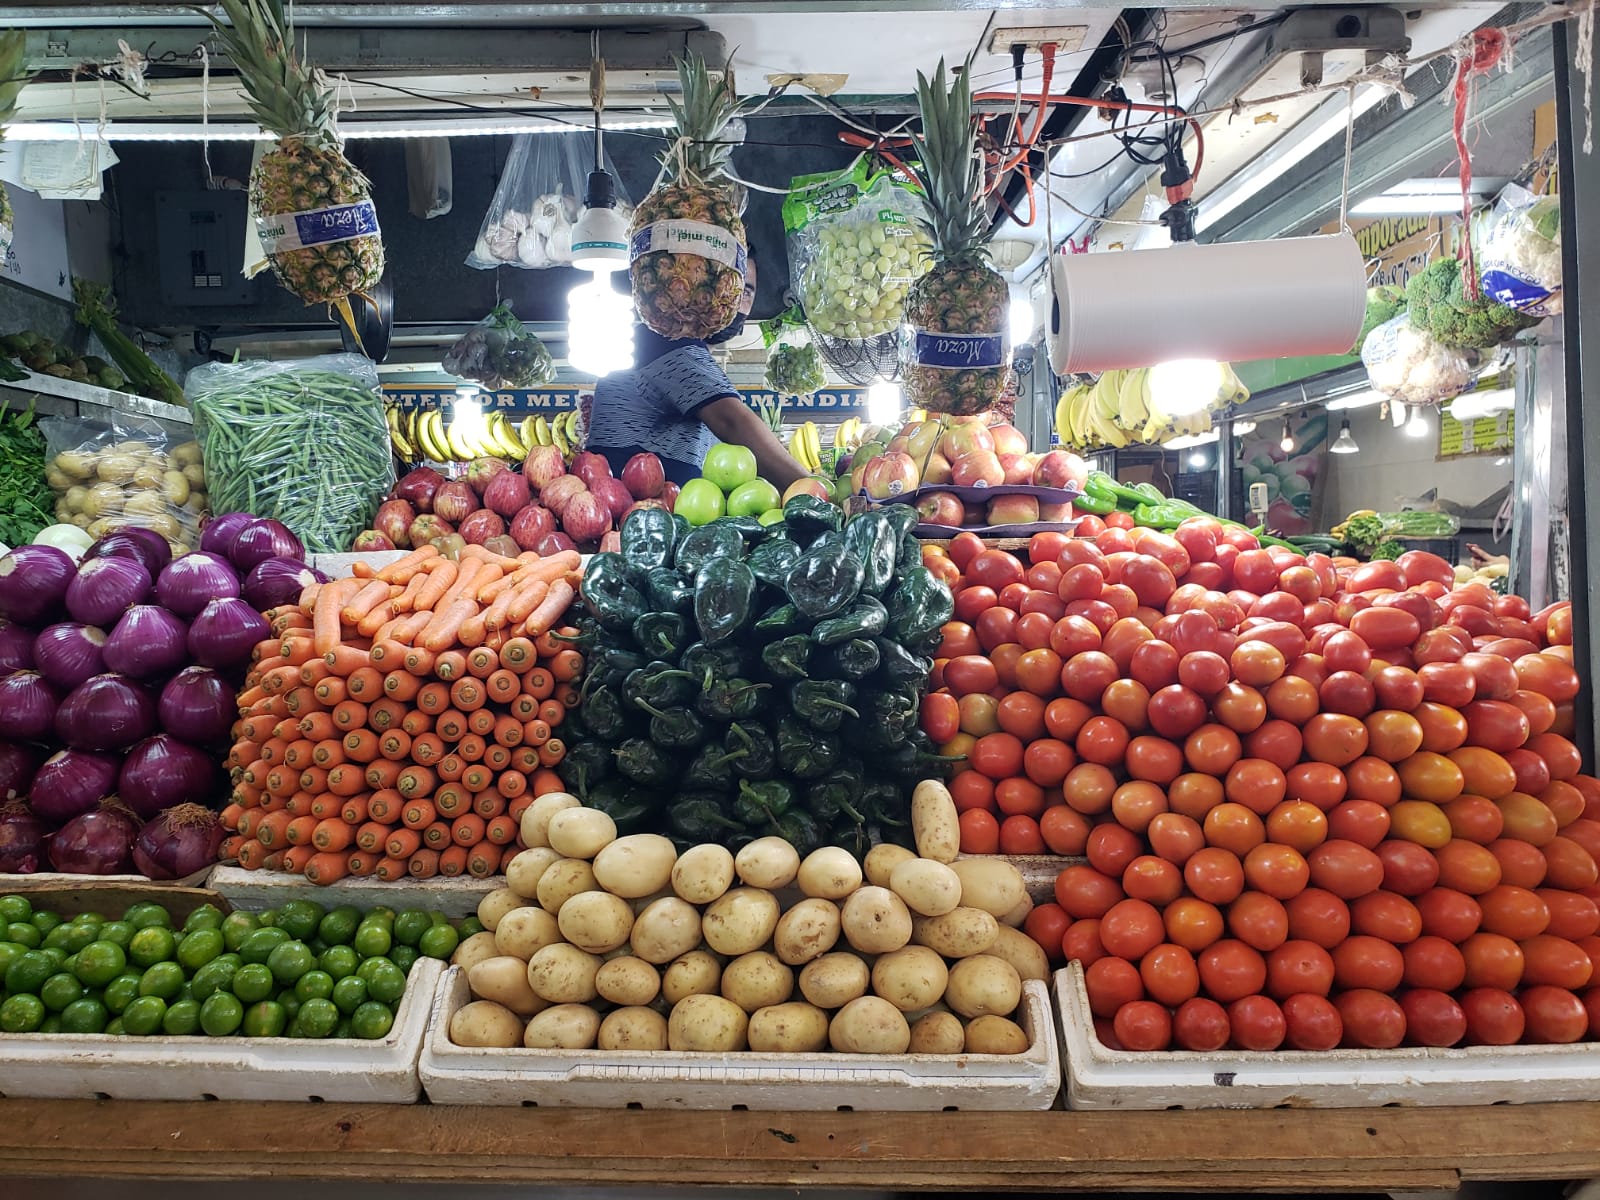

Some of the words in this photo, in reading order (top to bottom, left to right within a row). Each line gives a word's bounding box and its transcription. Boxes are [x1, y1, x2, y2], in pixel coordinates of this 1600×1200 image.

[935, 339, 986, 364] Meza
[382, 393, 516, 407] NTEROR
[527, 393, 578, 407] ME
[740, 394, 867, 407] MENDIA
